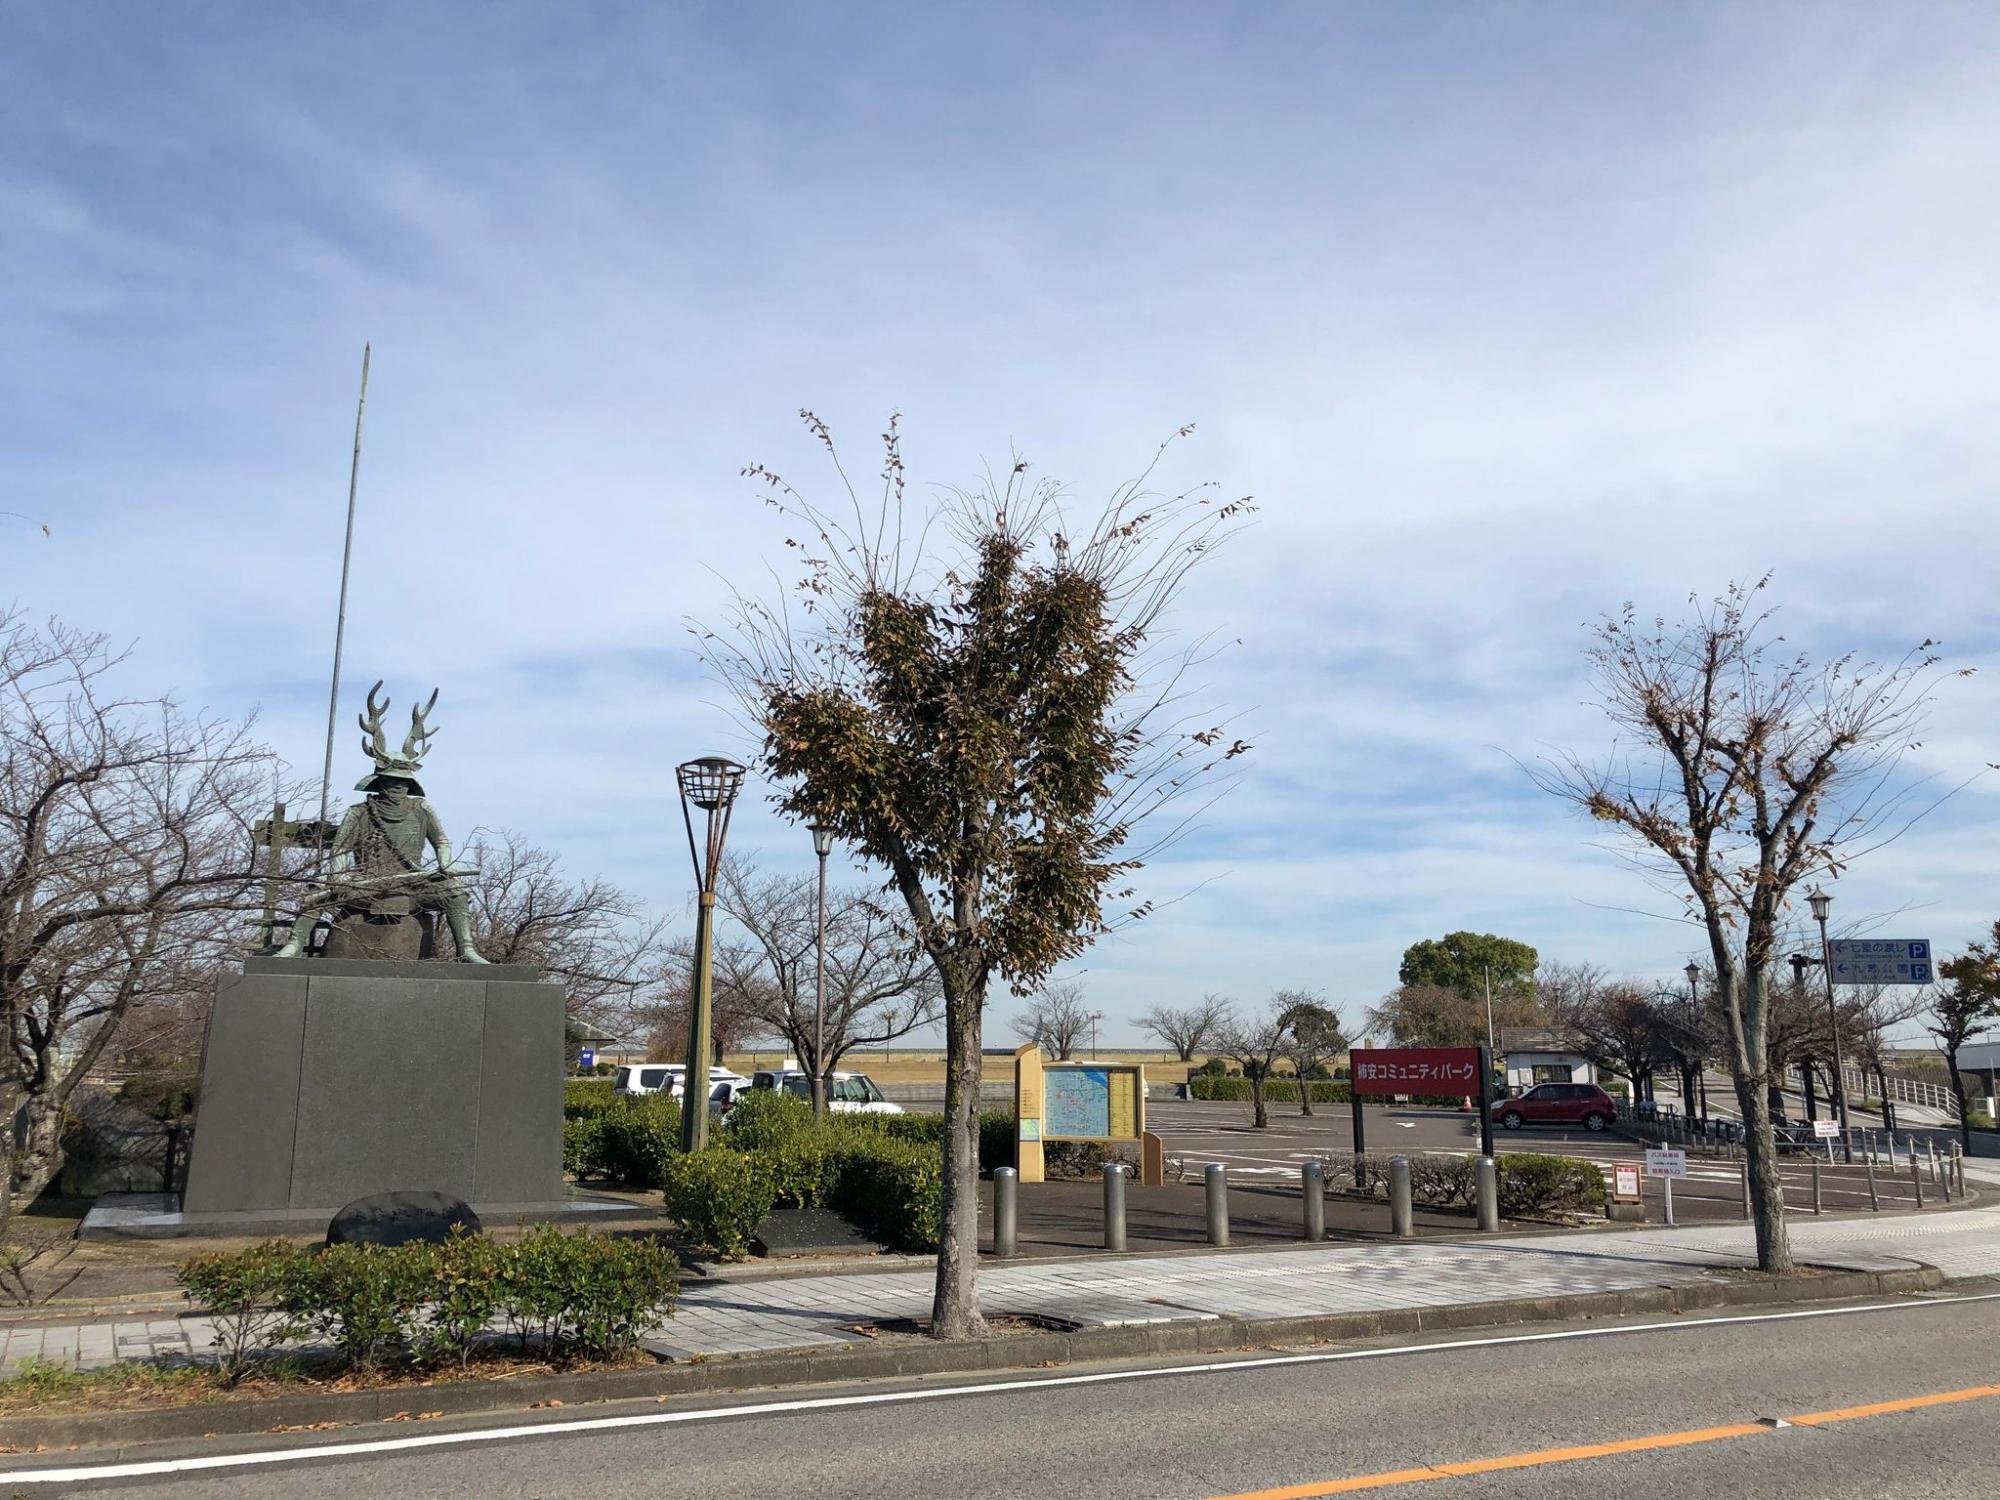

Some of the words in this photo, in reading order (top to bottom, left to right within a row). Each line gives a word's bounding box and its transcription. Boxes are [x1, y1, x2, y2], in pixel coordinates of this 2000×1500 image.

[1851, 943, 1905, 953] 七里の渡し
[1357, 1063, 1474, 1080] 柿安コミュニティパーク
